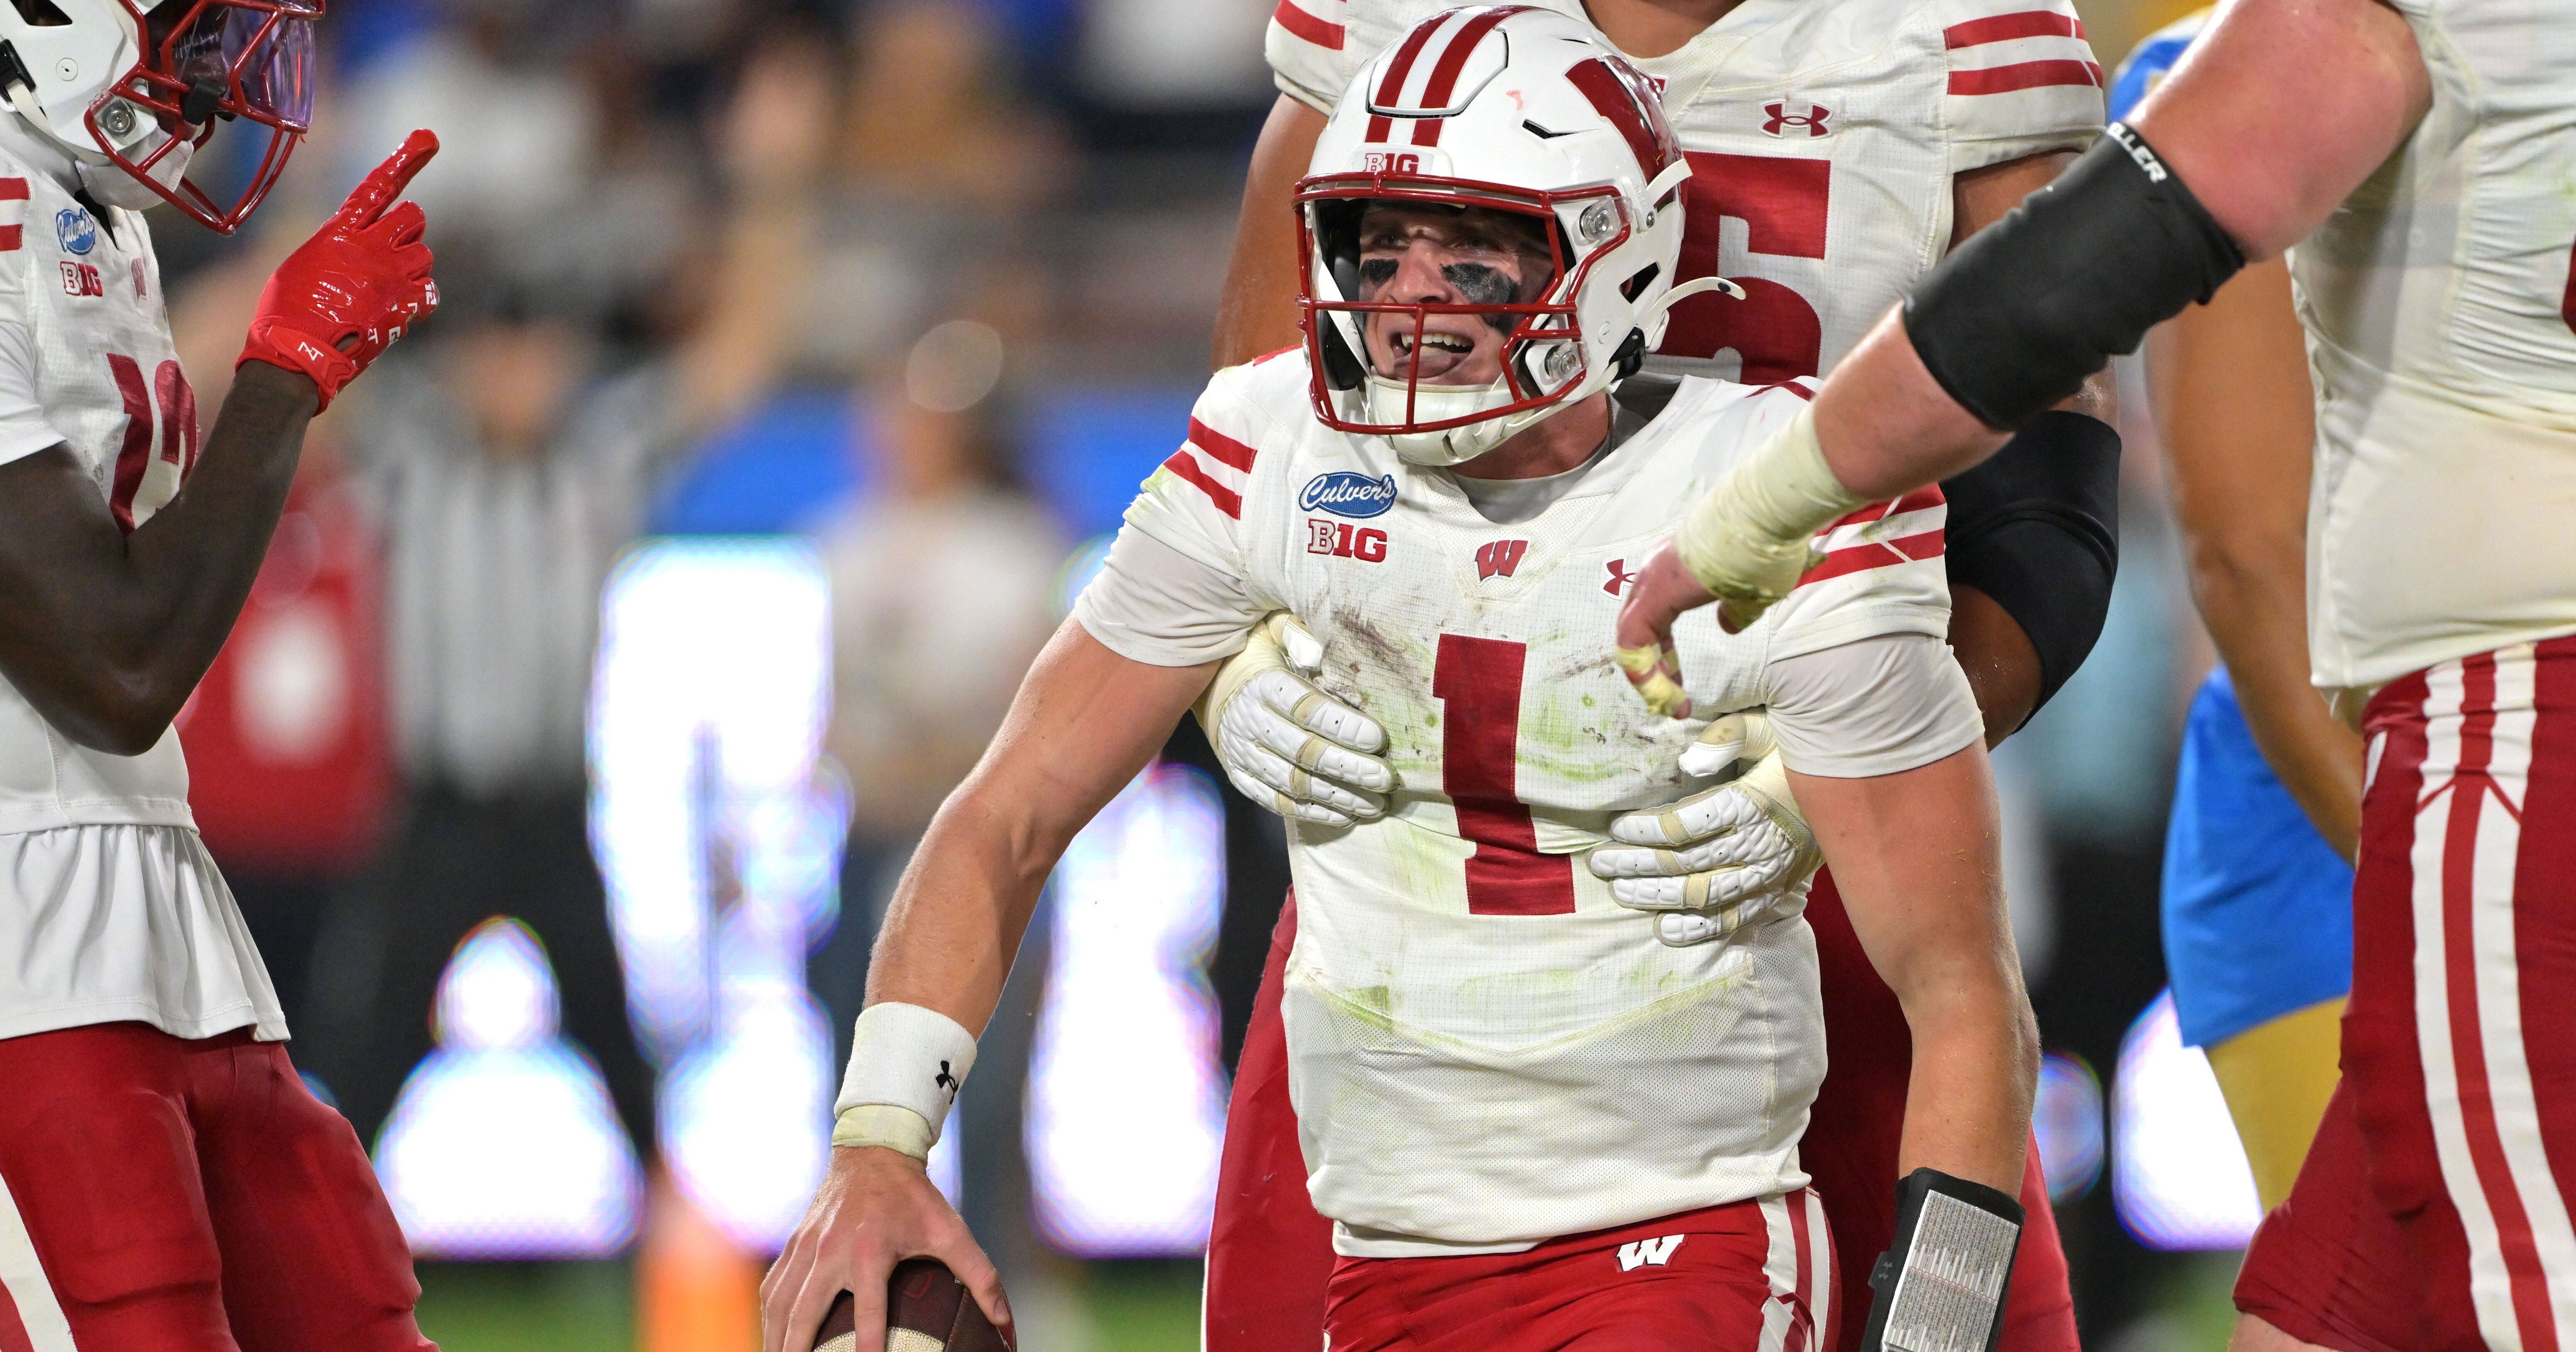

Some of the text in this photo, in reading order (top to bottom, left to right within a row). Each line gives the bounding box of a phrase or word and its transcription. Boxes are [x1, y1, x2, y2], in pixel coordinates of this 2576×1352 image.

[1299, 474, 1395, 509] Culver's
[1474, 539, 1528, 582] W
[1433, 633, 1576, 916] 1
[1615, 1234, 1685, 1272] W
